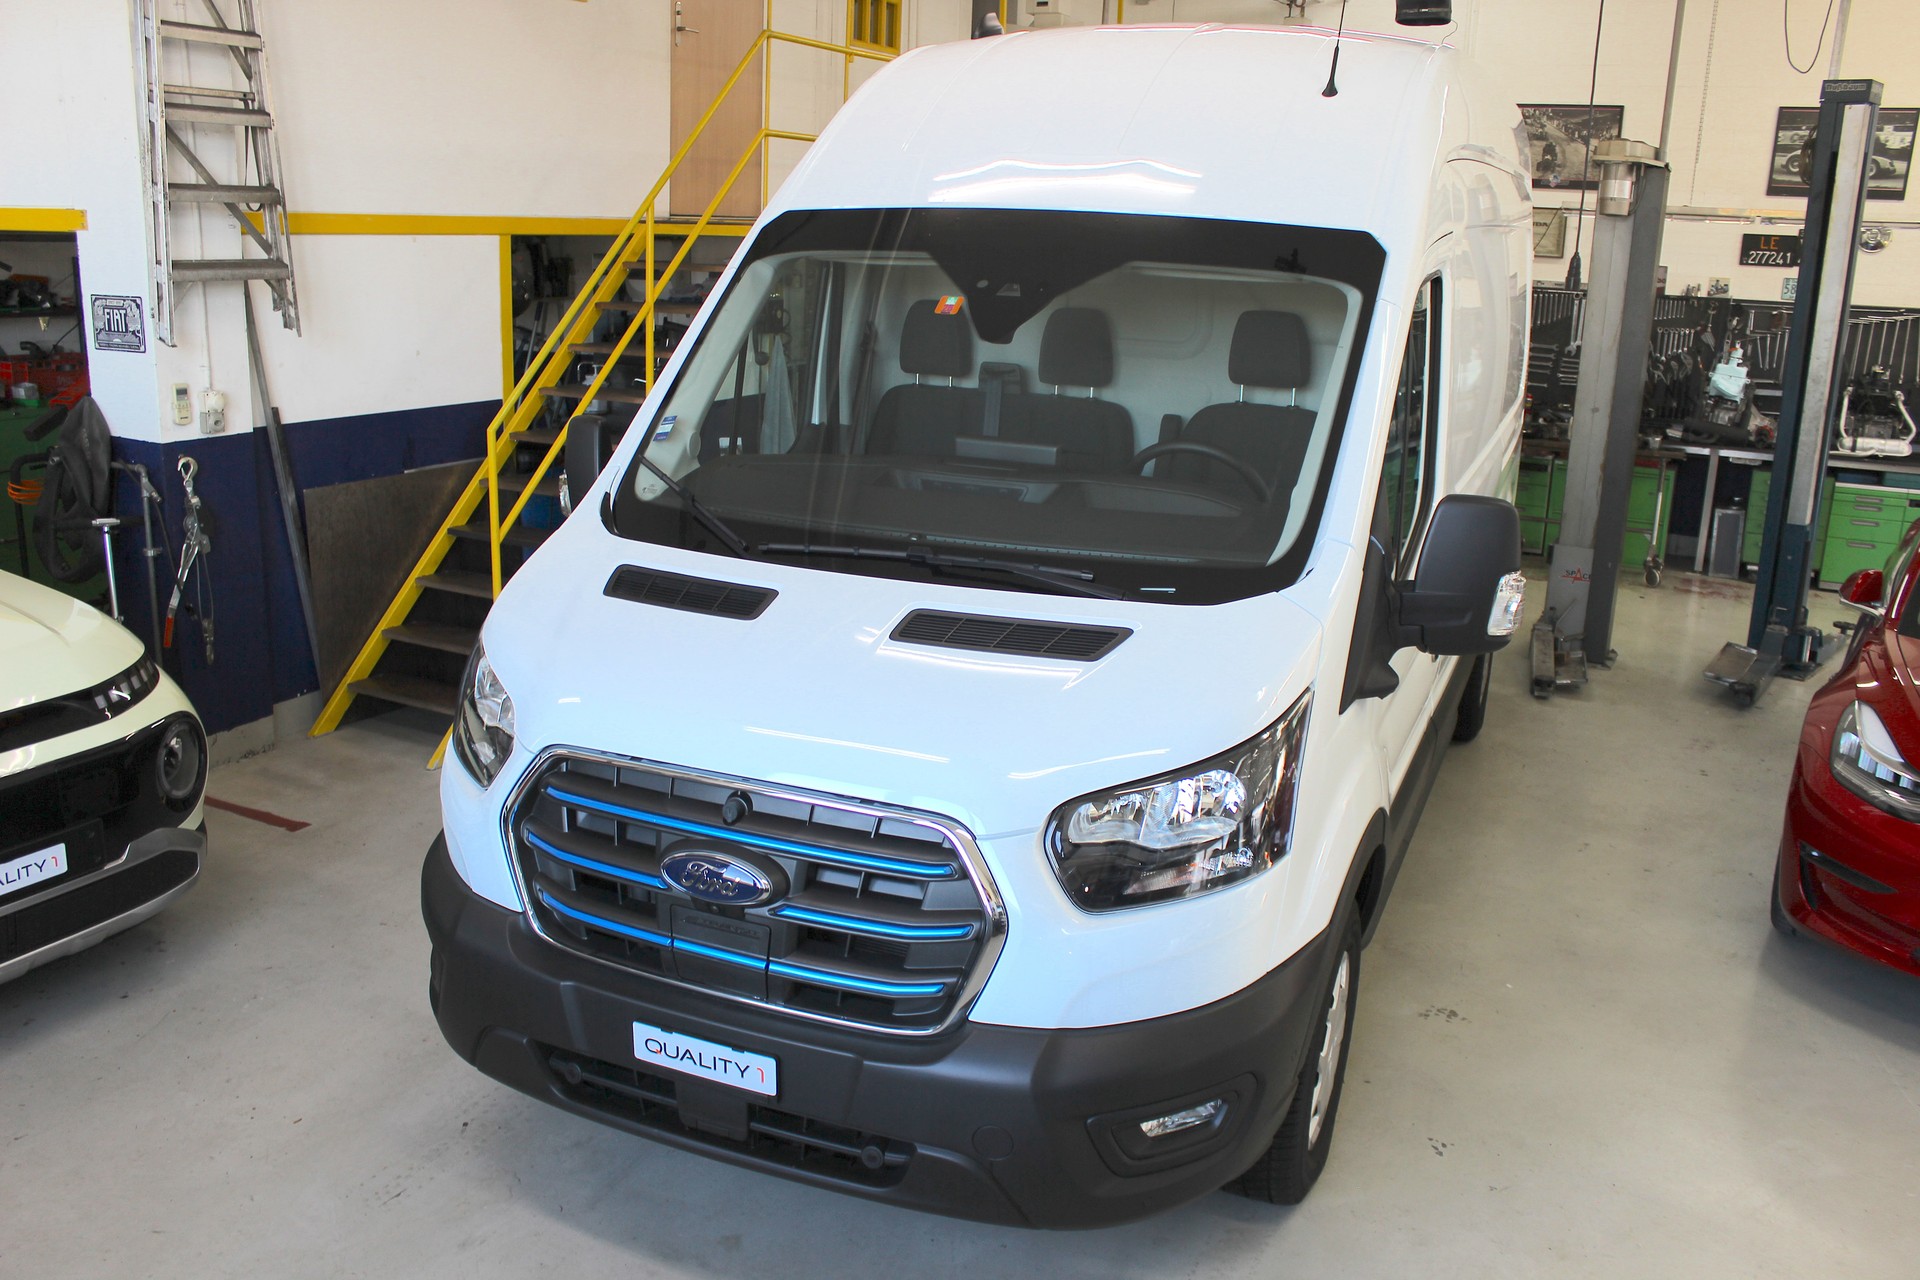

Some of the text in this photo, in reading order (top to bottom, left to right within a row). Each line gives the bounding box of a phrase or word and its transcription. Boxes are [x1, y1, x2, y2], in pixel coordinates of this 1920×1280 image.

[1760, 236, 1780, 250] LE
[1748, 250, 1792, 265] 277241
[104, 308, 127, 332] FIAT
[51, 856, 58, 867] 1
[681, 861, 739, 897] Ford
[644, 1038, 765, 1084] QUALITY 1
